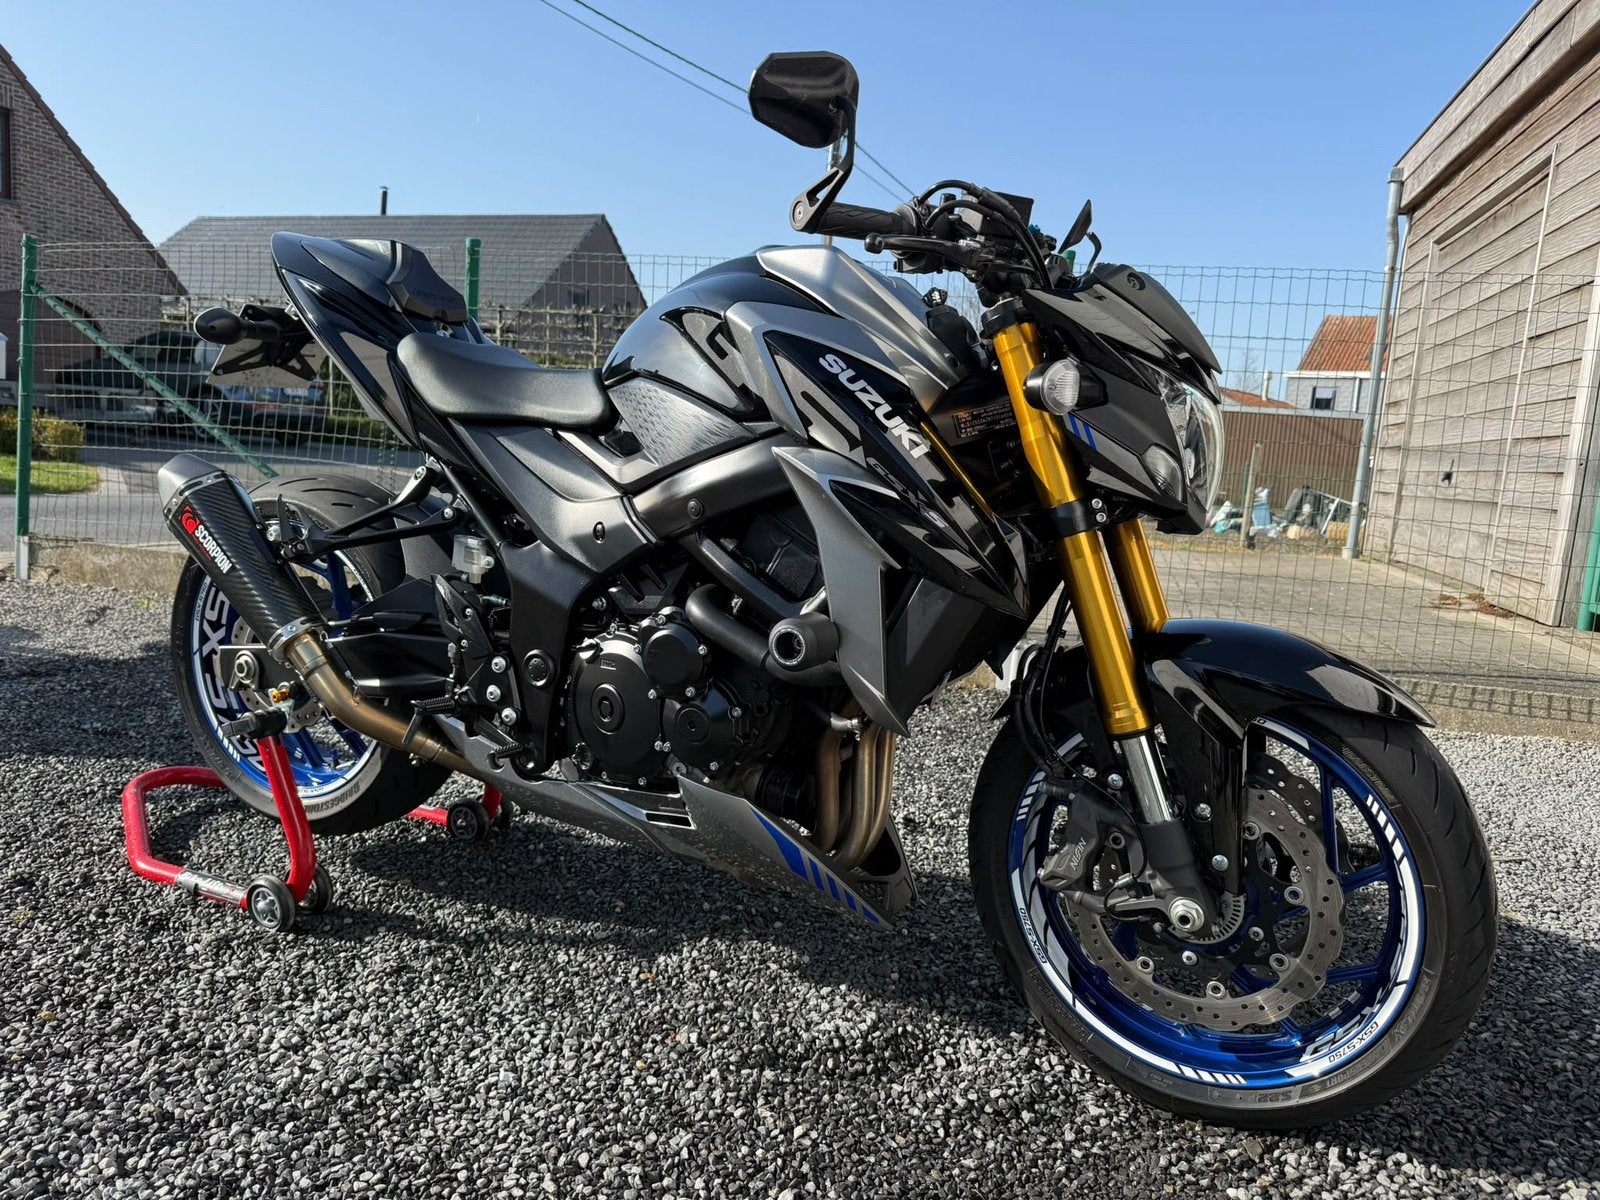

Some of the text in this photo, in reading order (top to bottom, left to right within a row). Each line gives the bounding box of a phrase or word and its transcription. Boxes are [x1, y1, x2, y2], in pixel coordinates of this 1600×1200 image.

[818, 353, 931, 459] SUZUKI
[866, 456, 949, 529] GSX-S
[195, 524, 233, 574] SCORPION
[303, 780, 361, 814] BRIDGESTON
[1069, 836, 1087, 871] NISSIN
[1018, 907, 1048, 965] GSX-S750
[1328, 1020, 1380, 1064] GSX-S750
